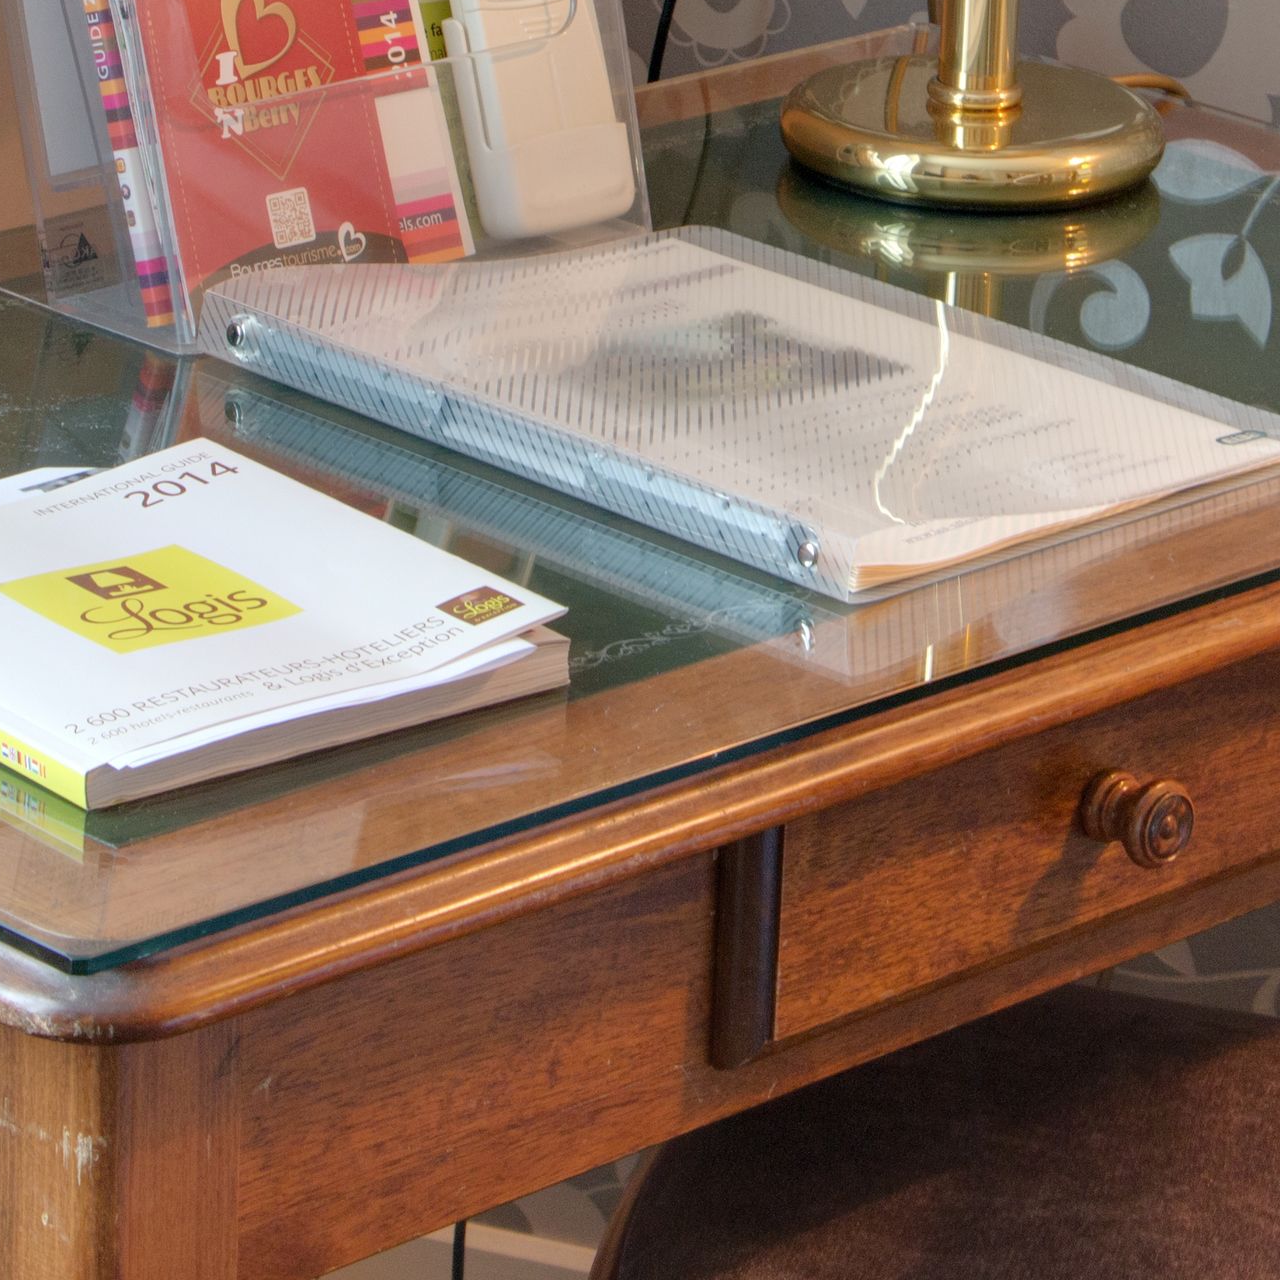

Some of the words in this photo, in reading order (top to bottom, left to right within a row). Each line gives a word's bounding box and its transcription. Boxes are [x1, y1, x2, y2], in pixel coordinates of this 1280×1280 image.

[86, 12, 110, 81] GUIDE
[207, 65, 322, 108] BOURGES
[33, 471, 161, 517] INTERNATIONAL
[160, 451, 213, 474] GUIDE
[124, 460, 239, 508] 2014
[80, 590, 268, 640] Logis
[453, 594, 510, 619] Logis
[261, 680, 283, 692] &
[285, 668, 344, 688] Logis
[345, 626, 465, 673] d'Exception
[65, 723, 85, 735] 2
[86, 706, 131, 727] 600
[87, 736, 97, 746] 2
[101, 726, 128, 741] 600
